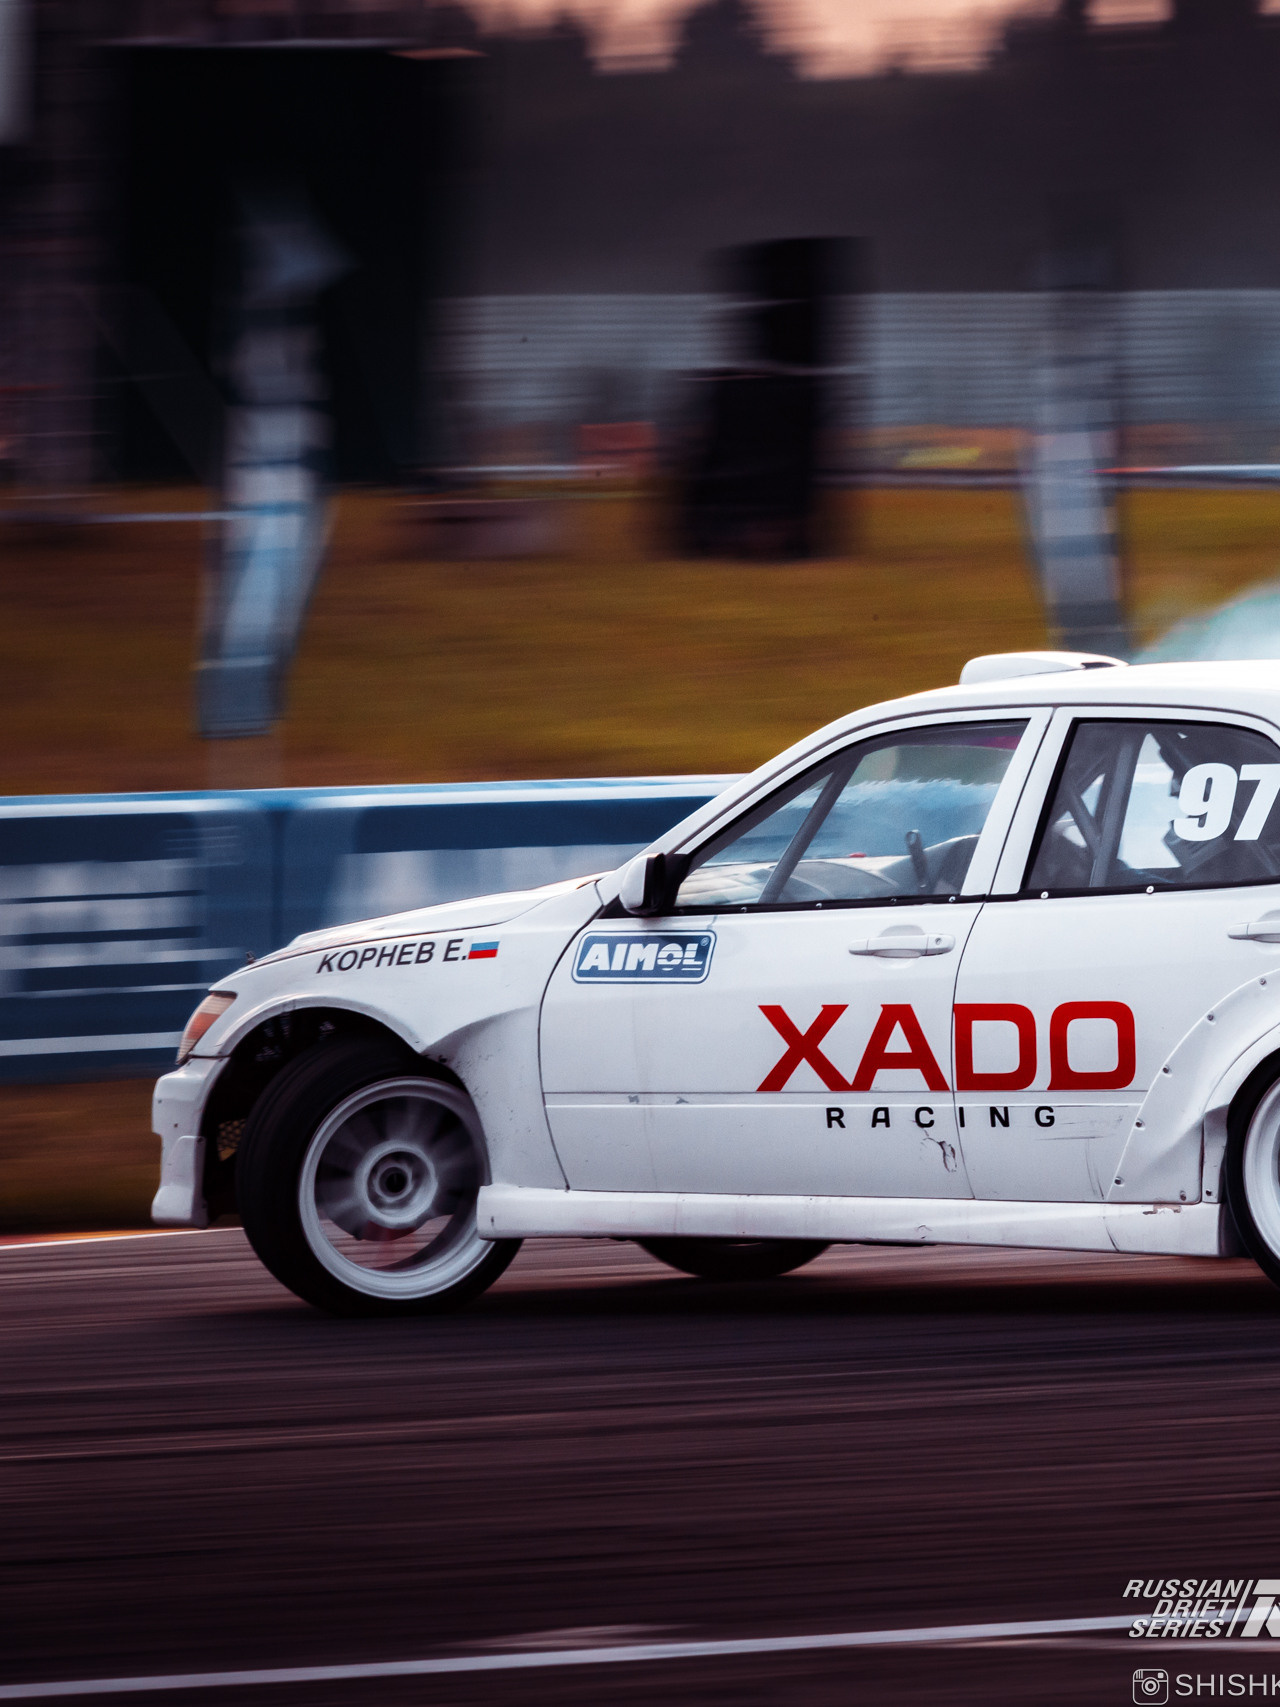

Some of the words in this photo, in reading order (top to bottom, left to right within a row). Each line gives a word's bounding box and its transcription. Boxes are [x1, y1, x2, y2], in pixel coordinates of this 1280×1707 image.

[316, 941, 435, 974] КОРНЕВ
[579, 943, 703, 971] AIMOL
[756, 1001, 1136, 1092] XADO
[826, 1106, 1055, 1129] RACING
